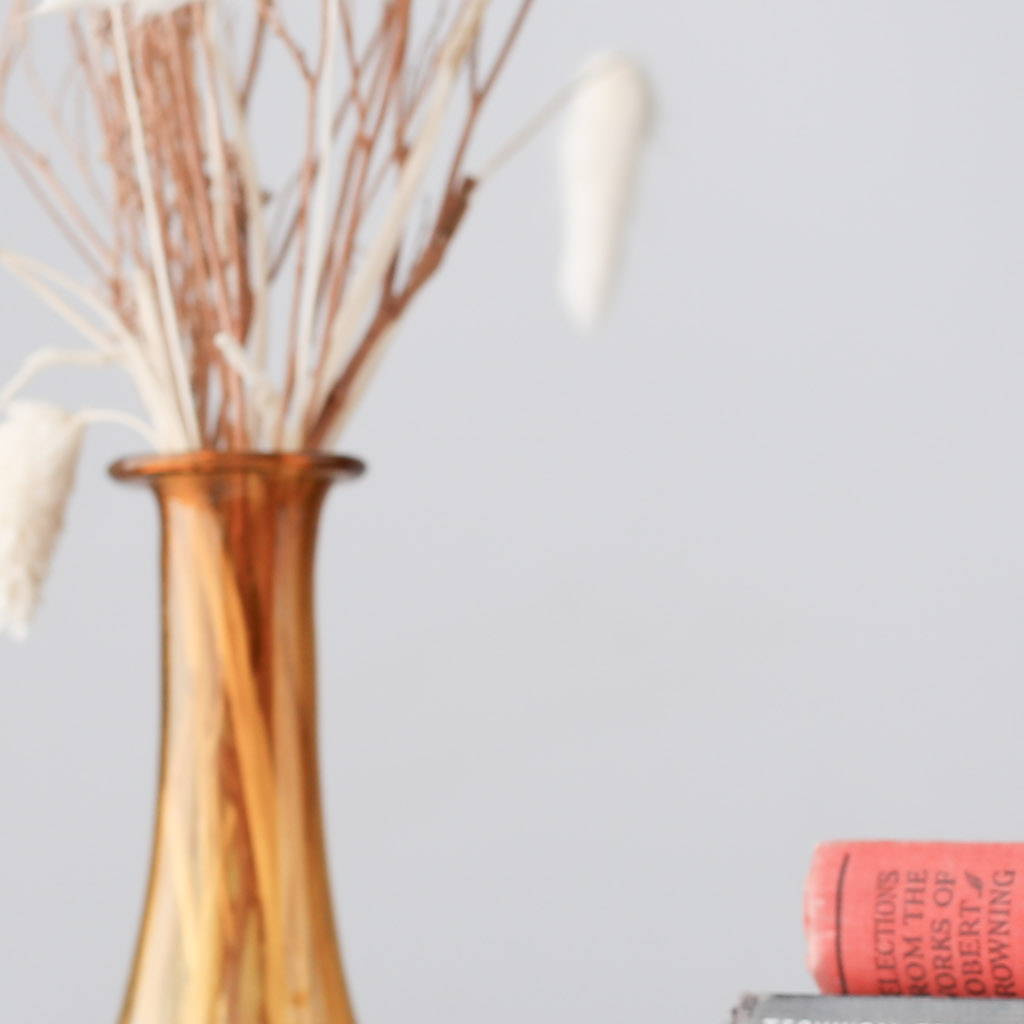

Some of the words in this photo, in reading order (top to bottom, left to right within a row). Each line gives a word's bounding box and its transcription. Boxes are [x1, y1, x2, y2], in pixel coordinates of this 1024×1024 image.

[903, 868, 928, 925] THE
[933, 870, 957, 908] OF
[874, 869, 900, 996] ELECTIONS
[902, 935, 929, 996] ROM
[931, 918, 957, 997] ORKS
[959, 899, 987, 997] OBERT
[988, 869, 1016, 997] ROWNING
